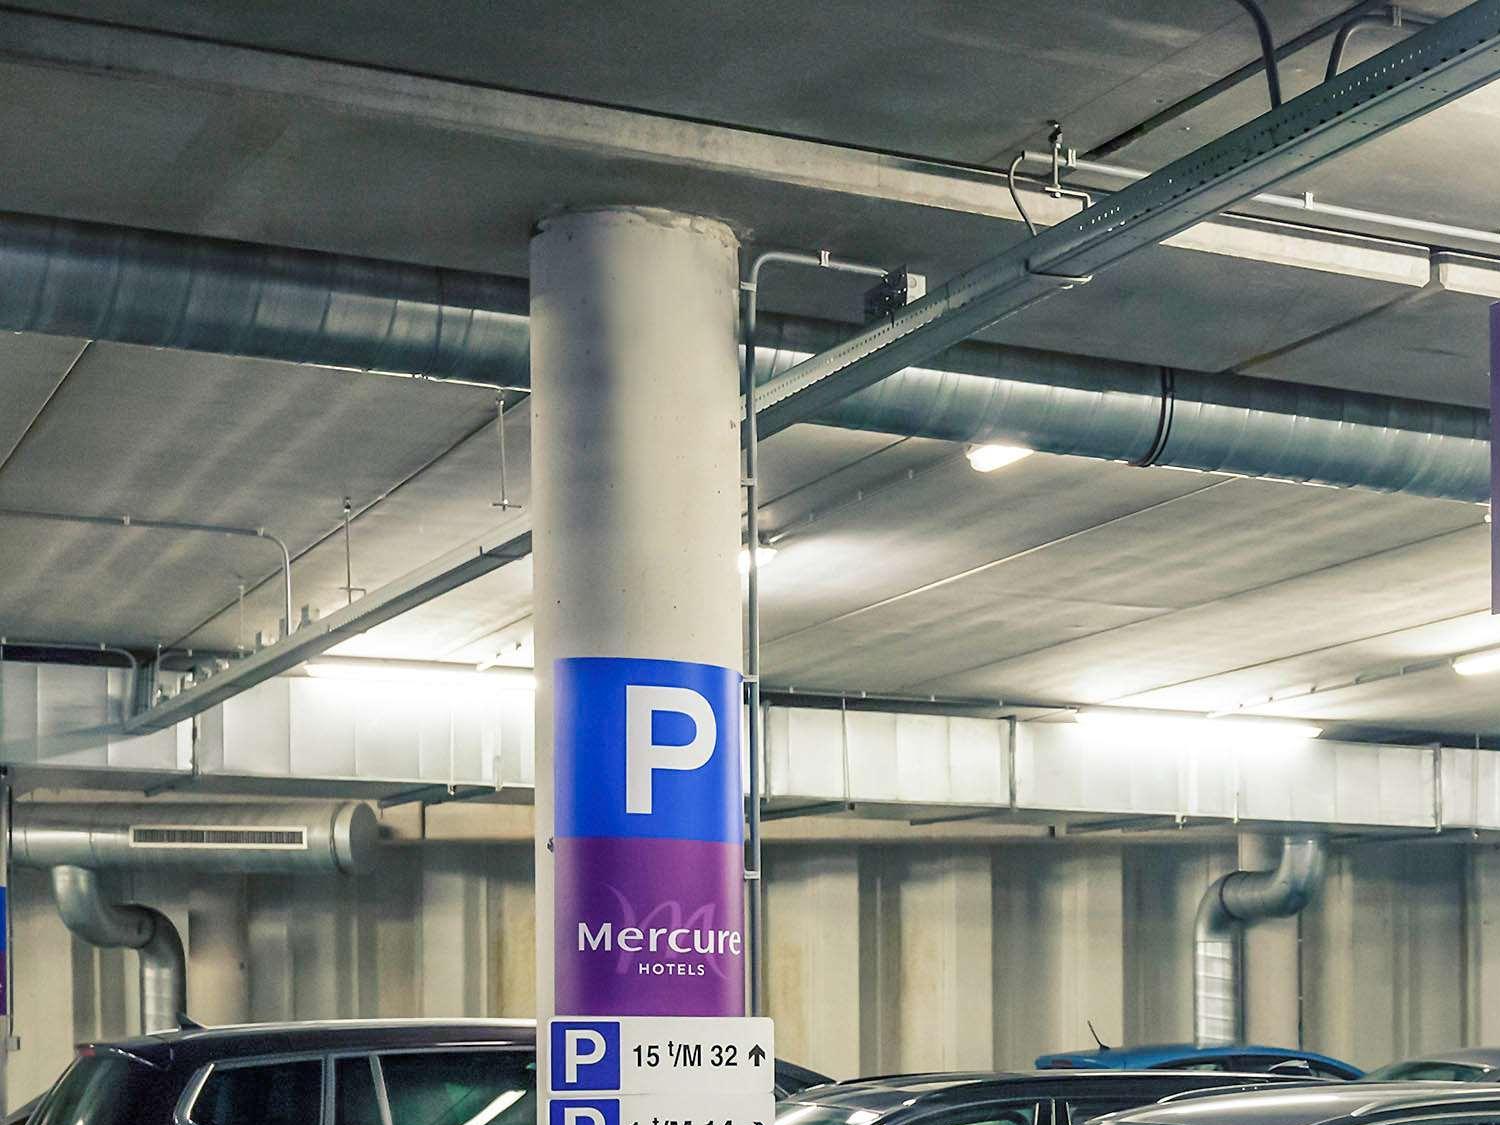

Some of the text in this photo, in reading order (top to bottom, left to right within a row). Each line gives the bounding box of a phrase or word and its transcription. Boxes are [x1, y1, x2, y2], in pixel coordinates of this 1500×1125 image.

[625, 684, 717, 815] P
[577, 921, 742, 956] Mercure
[638, 962, 706, 977] HOTELS
[564, 1028, 607, 1084] P
[632, 1044, 661, 1068] 15
[709, 1044, 738, 1068] 32
